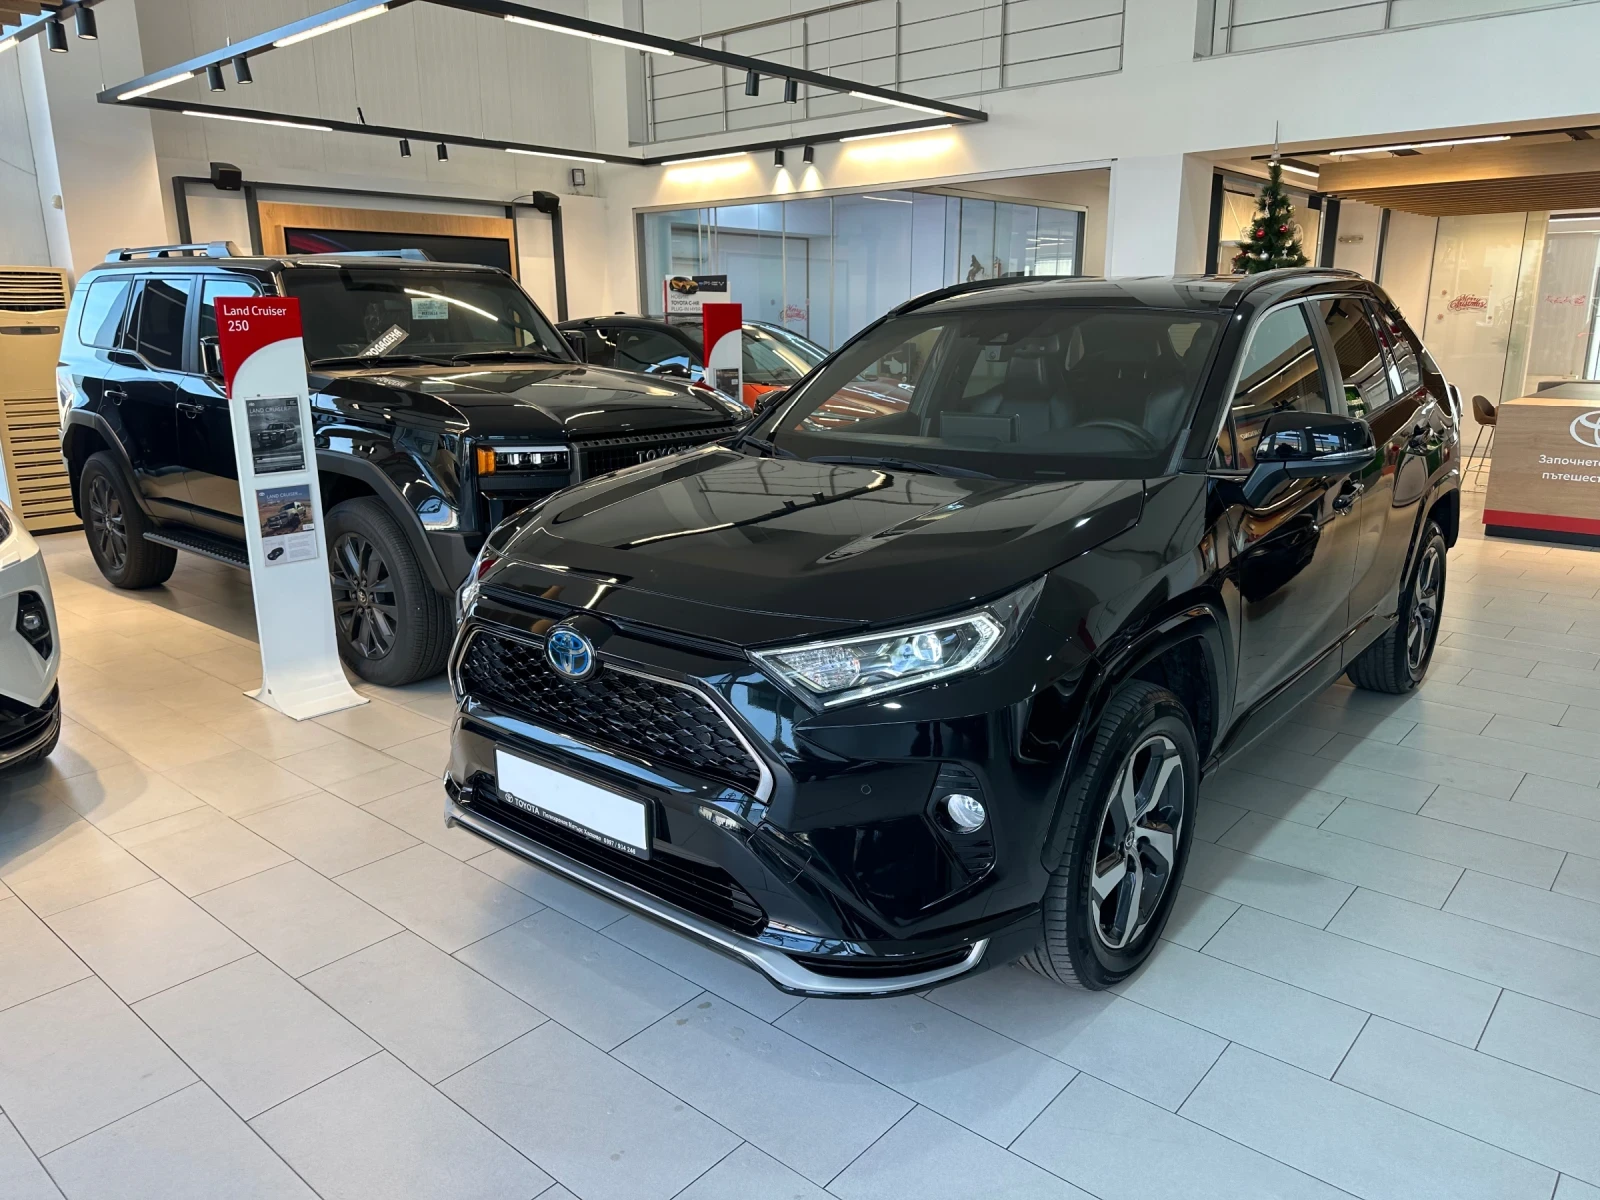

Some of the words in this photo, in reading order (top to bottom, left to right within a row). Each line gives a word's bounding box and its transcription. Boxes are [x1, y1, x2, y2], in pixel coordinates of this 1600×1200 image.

[223, 304, 250, 316] Land
[251, 305, 287, 316] Cruiser
[227, 319, 250, 332] 250
[362, 328, 403, 357] РОДАДЕНА
[514, 798, 540, 815] TOYOTA
